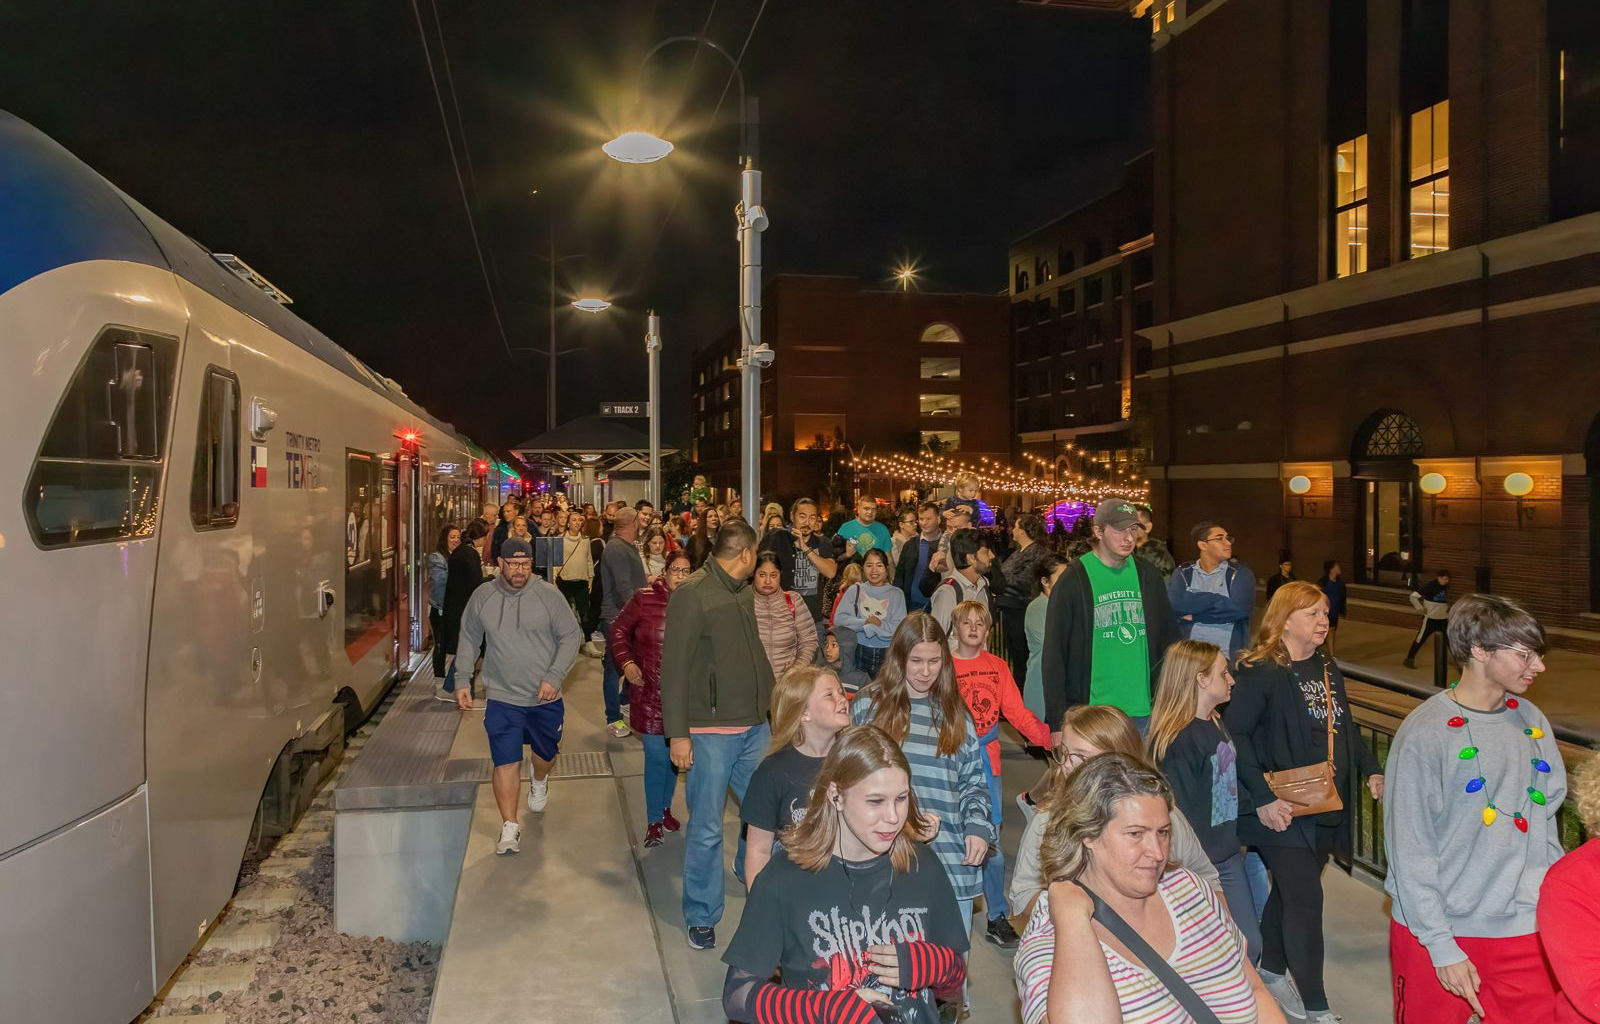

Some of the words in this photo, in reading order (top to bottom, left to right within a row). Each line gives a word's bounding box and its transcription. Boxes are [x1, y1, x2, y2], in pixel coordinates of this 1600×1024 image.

[613, 405, 634, 414] TRACK
[634, 405, 640, 414] 2
[285, 431, 305, 450] TRINITY
[305, 436, 321, 452] METRO
[1098, 590, 1135, 603] UNIVERSITY
